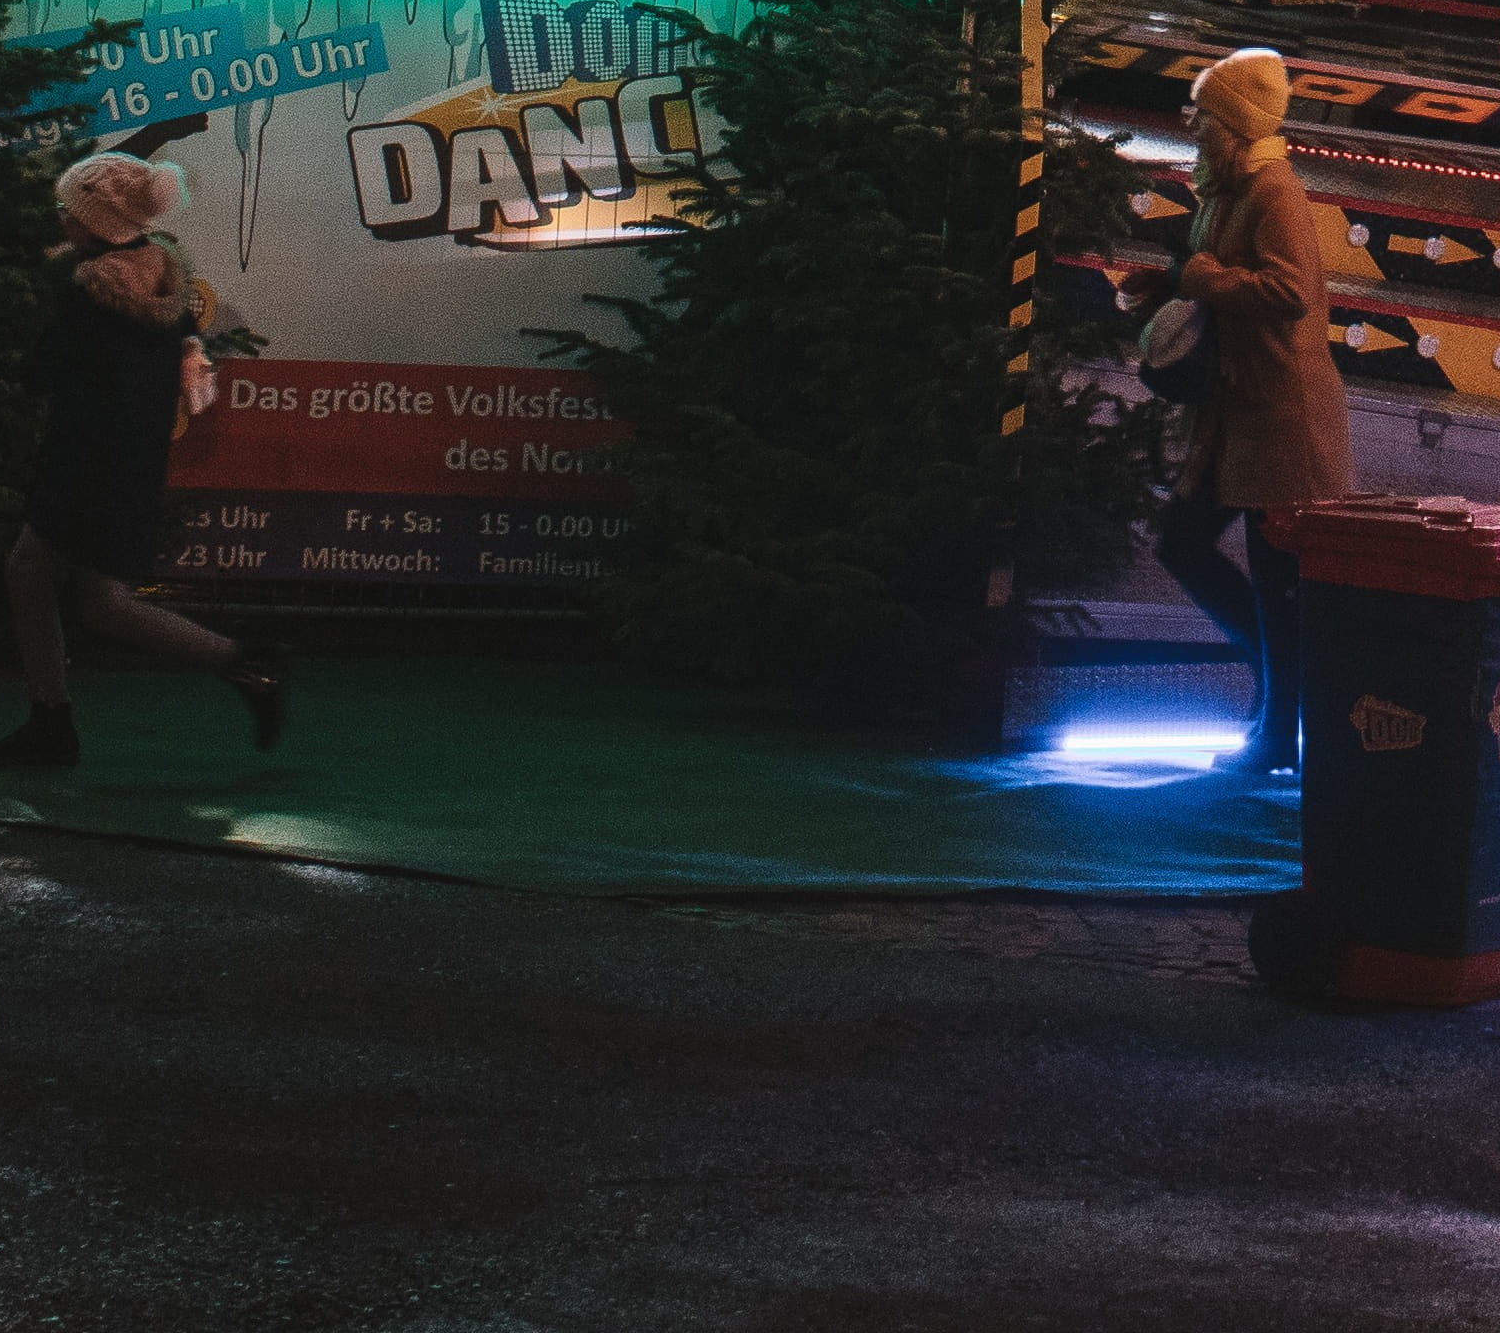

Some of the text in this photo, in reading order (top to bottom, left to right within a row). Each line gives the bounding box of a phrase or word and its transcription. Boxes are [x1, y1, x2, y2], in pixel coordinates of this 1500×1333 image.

[138, 25, 219, 65] Uhr
[100, 82, 152, 122] 16
[190, 52, 280, 101] 0.00
[292, 34, 373, 85] Uhr
[230, 378, 299, 412] Das
[308, 380, 435, 419] größte
[444, 439, 509, 473] des
[220, 505, 272, 533] Uhr
[344, 509, 375, 533] Fr
[403, 509, 443, 535] Sa:
[479, 512, 511, 537] 15
[534, 513, 595, 538] 0.00
[215, 544, 268, 570] Uhr
[301, 545, 442, 574] Mittwoch:
